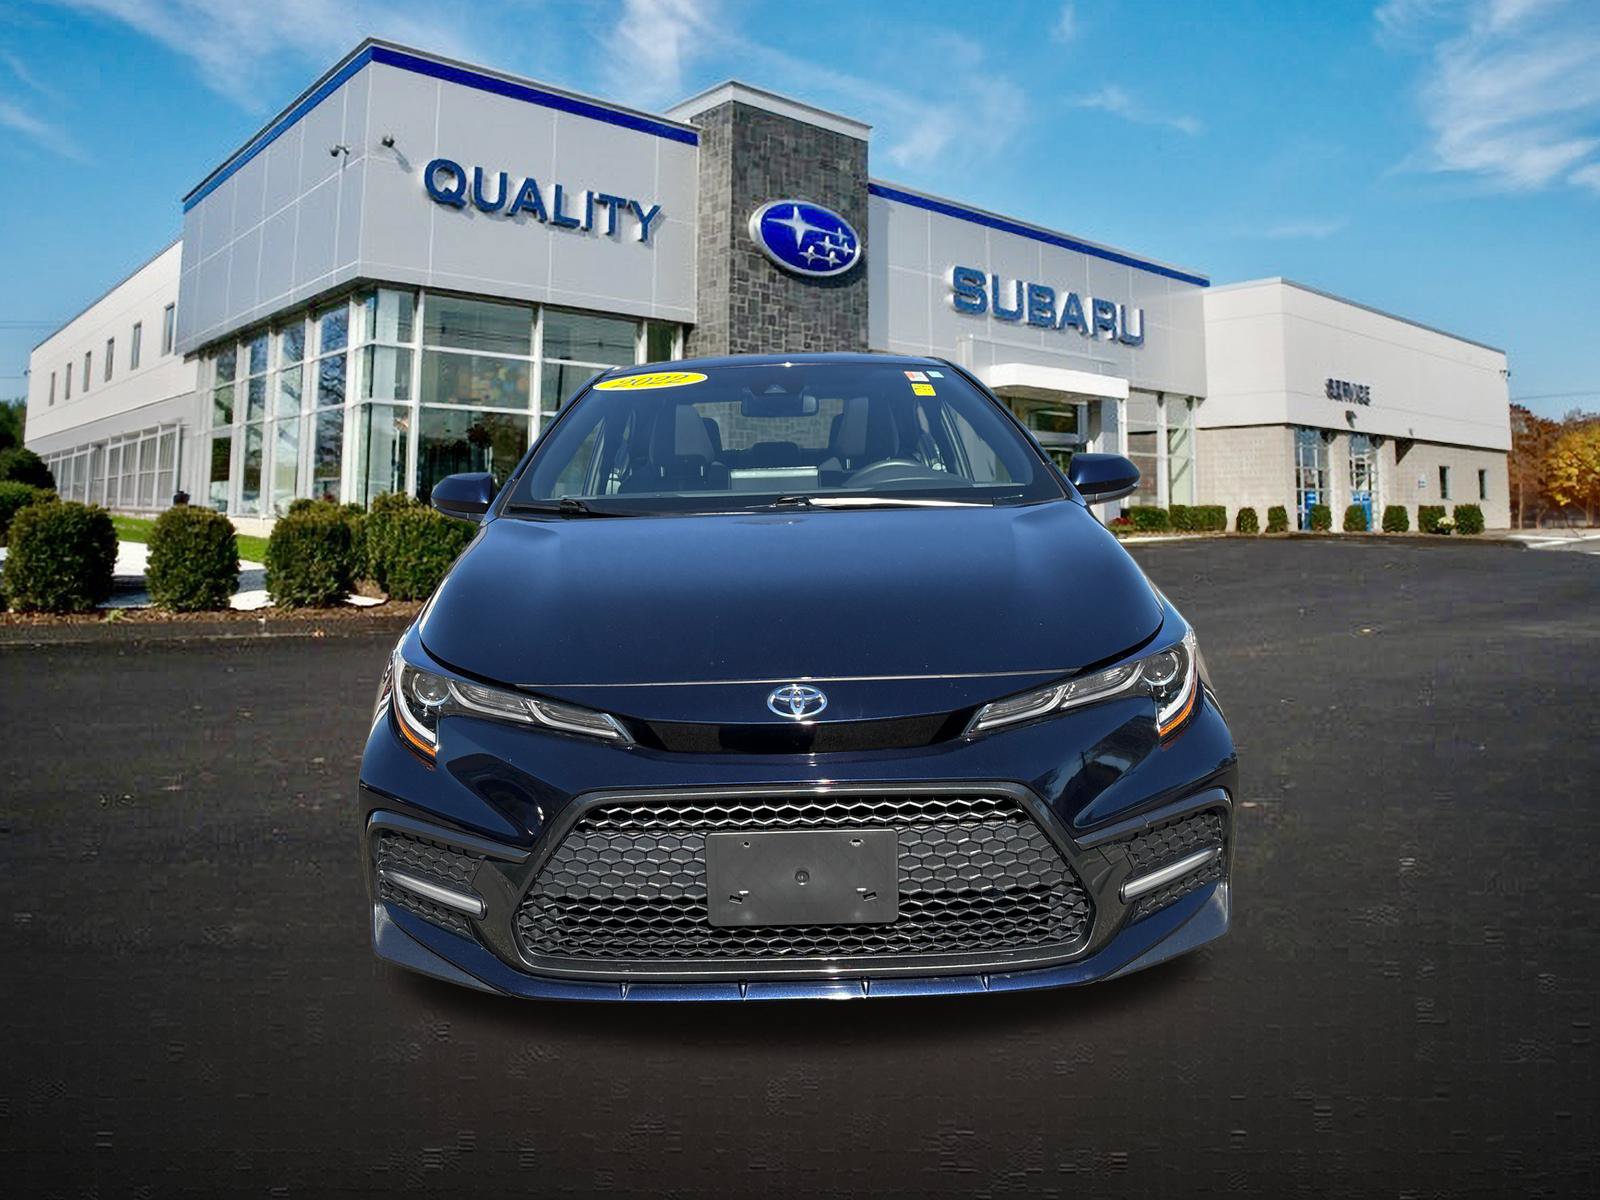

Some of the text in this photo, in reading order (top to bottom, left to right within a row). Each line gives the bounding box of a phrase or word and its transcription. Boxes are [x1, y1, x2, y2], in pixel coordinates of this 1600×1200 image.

[424, 158, 662, 242] QUALITY
[951, 265, 1145, 346] SUBARU
[610, 374, 690, 389] 2022
